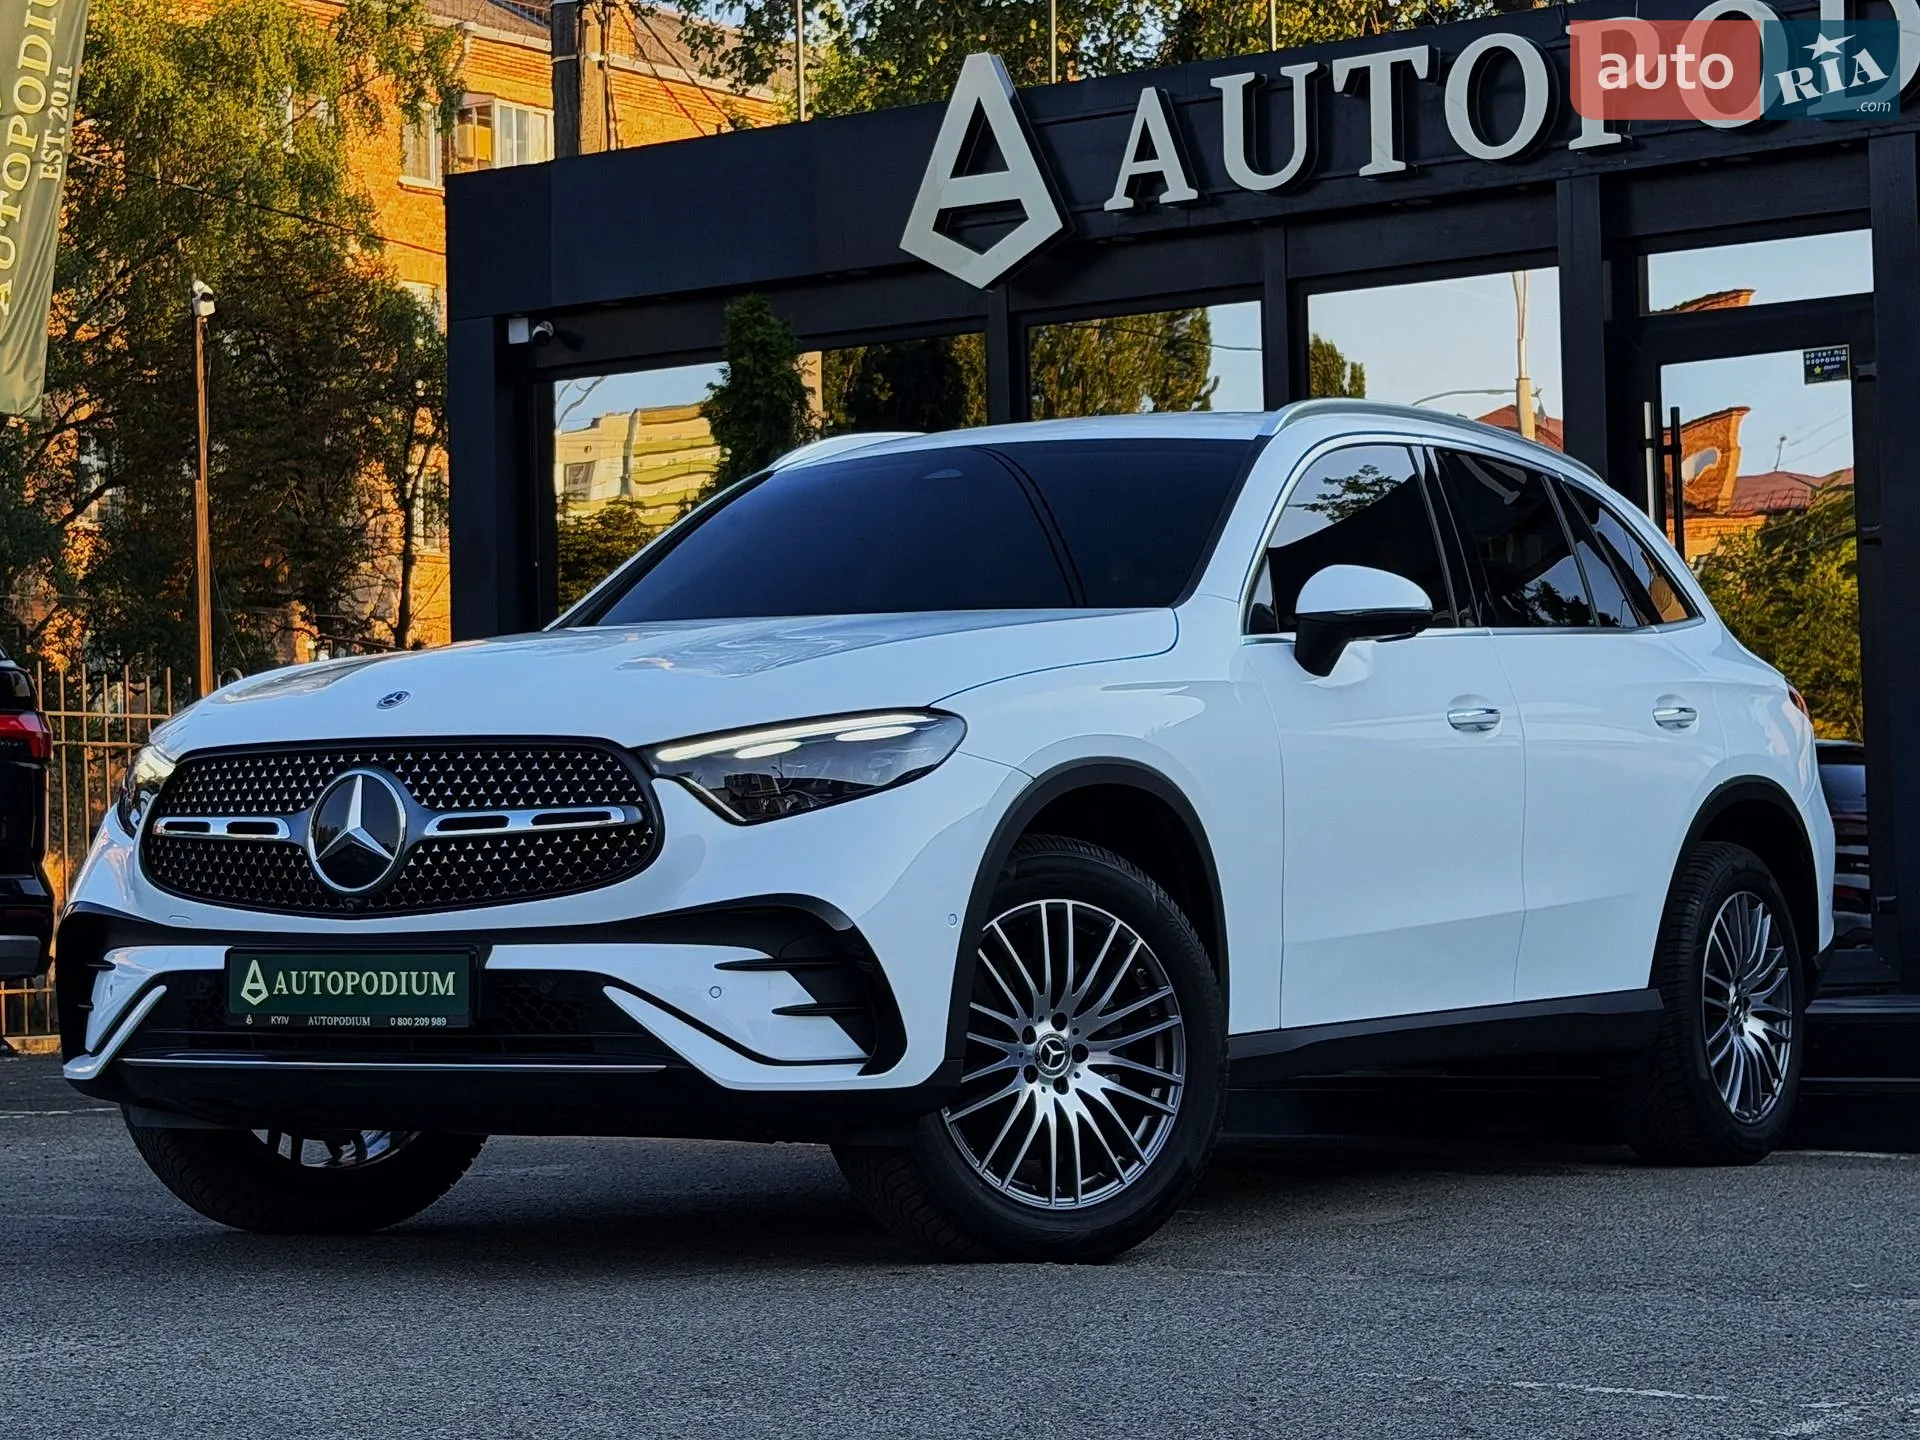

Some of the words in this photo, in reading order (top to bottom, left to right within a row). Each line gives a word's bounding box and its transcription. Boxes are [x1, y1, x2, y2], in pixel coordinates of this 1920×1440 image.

[47, 65, 73, 122] 2011
[0, 0, 58, 317] AUTOPODI
[39, 129, 65, 182] EST.
[272, 971, 456, 996] AUTOPODIUM
[270, 1015, 290, 1026] KYIV
[308, 1016, 371, 1027] AUTOPODIUM
[397, 1017, 413, 1026] 800
[414, 1017, 430, 1026] 209
[431, 1017, 447, 1026] 989
